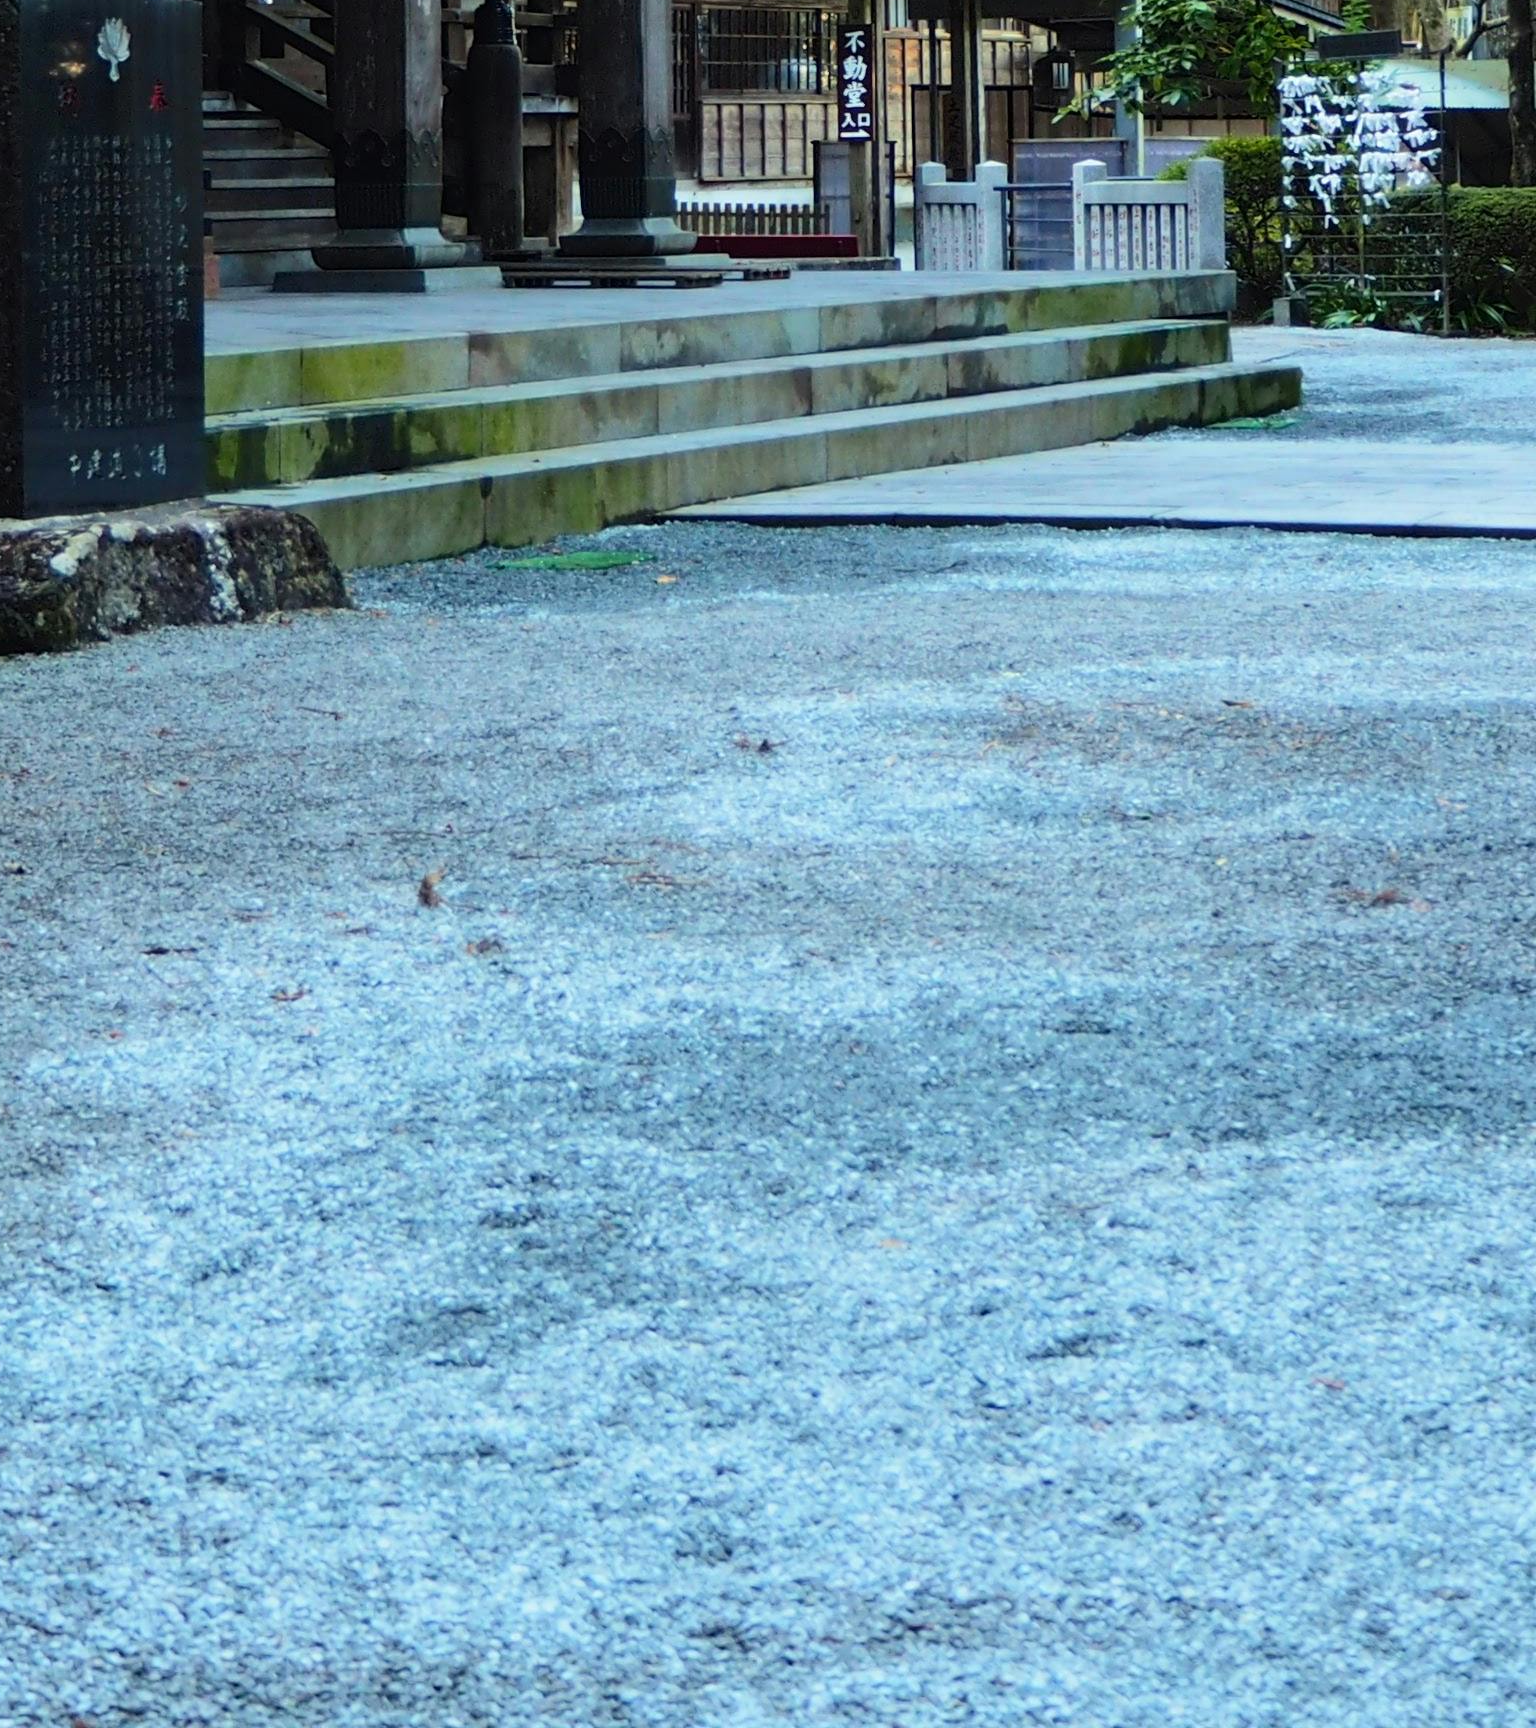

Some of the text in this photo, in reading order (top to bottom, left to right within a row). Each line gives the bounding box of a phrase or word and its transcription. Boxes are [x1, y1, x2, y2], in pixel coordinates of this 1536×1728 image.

[843, 31, 868, 108] 不動堂
[841, 113, 871, 128] 入口
